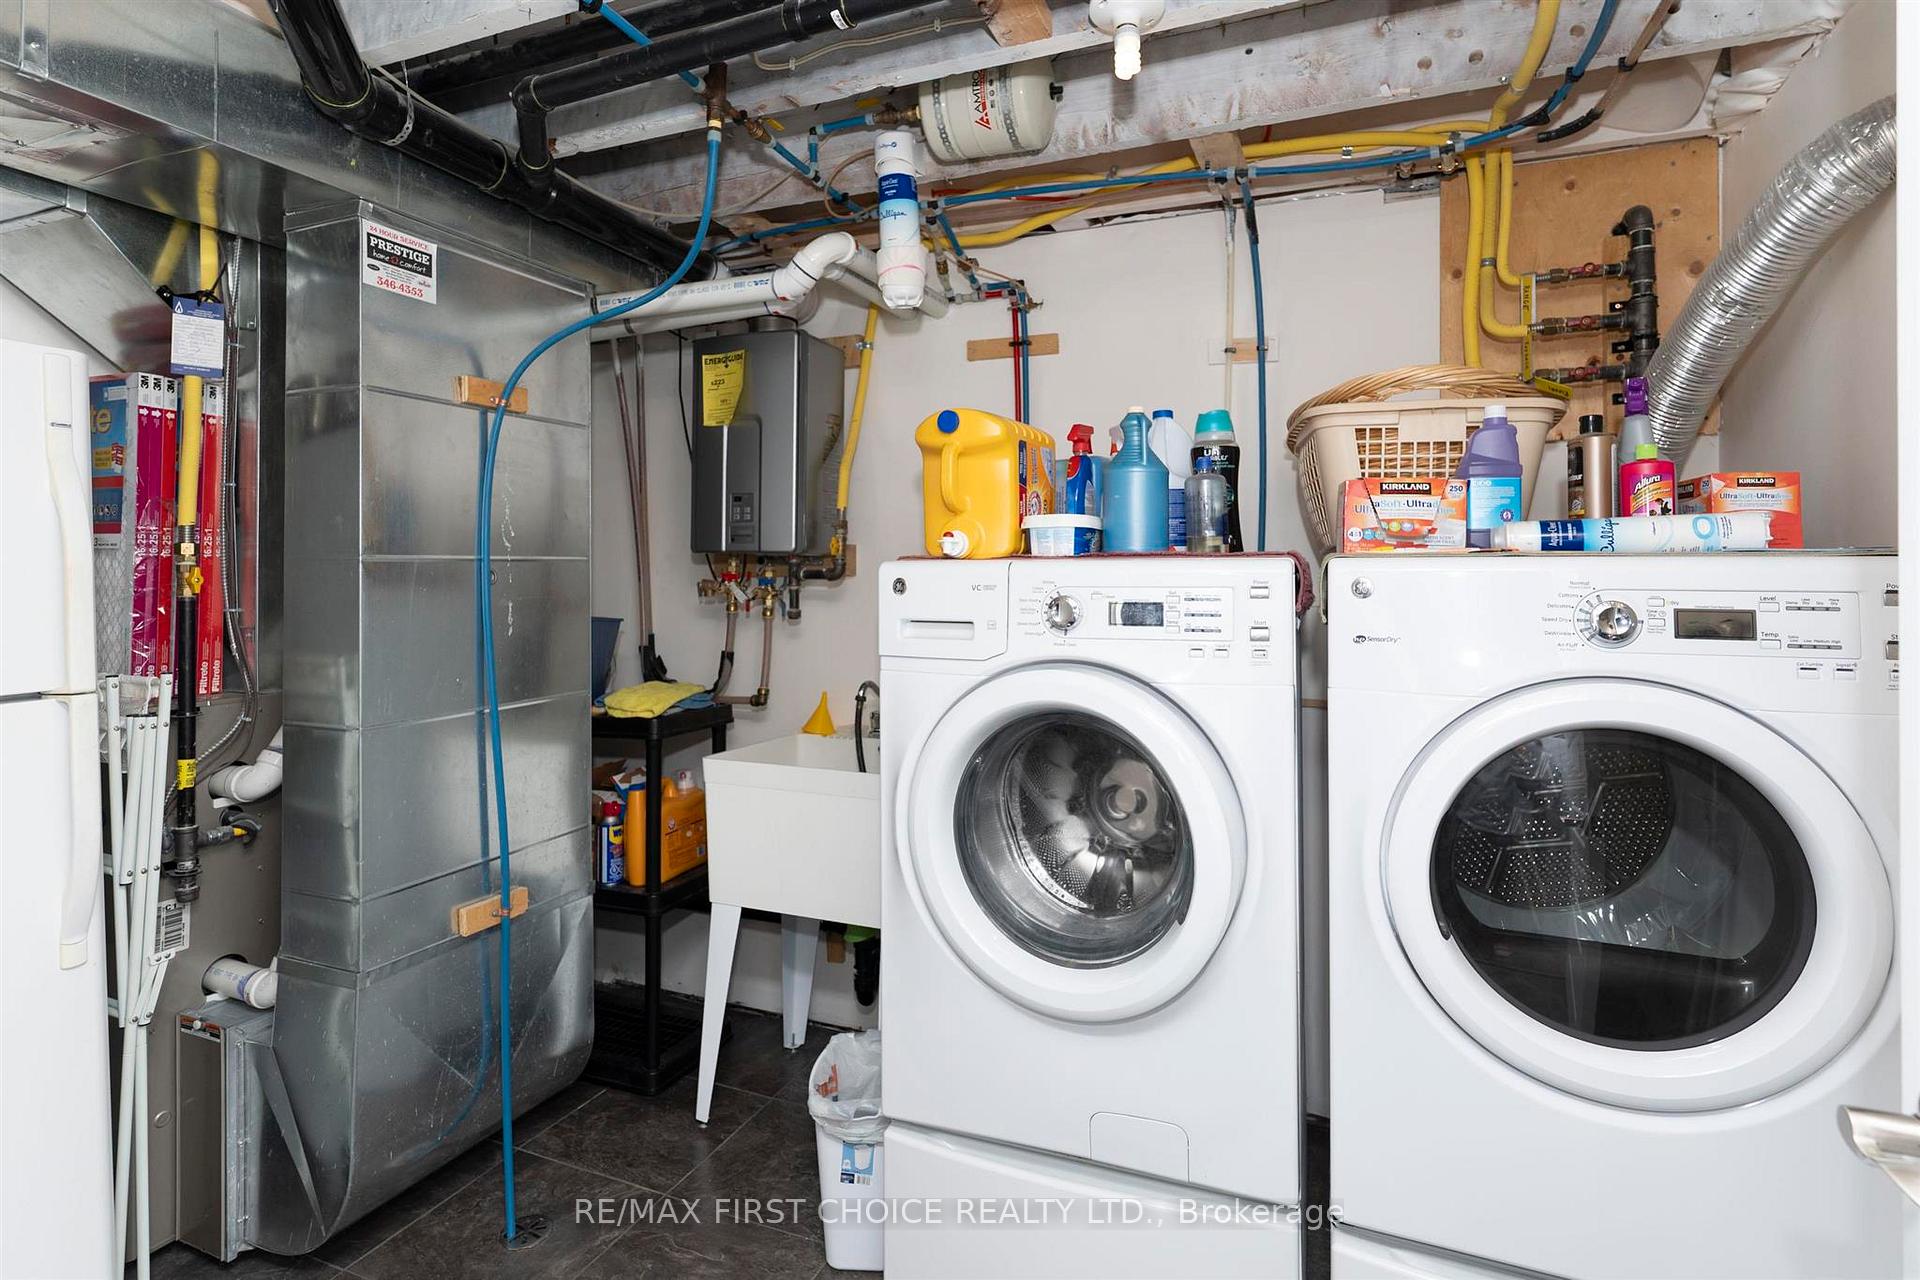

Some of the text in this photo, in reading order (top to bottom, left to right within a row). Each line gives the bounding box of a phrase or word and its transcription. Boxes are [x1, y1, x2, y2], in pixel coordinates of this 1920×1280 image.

[972, 71, 983, 113] AMTRO
[370, 236, 430, 265] PRESTIGE
[399, 235, 428, 250] SERVICE
[372, 250, 426, 273] home comfort
[376, 276, 424, 298] 346-4353
[141, 376, 149, 389] 3M
[154, 378, 162, 392] 3M
[167, 380, 176, 393] 3M
[210, 386, 217, 400] 3M
[1634, 474, 1661, 494] Allura
[1600, 519, 1619, 552] Culliga
[199, 661, 208, 694] Filtrete
[212, 660, 220, 692] Filtrete
